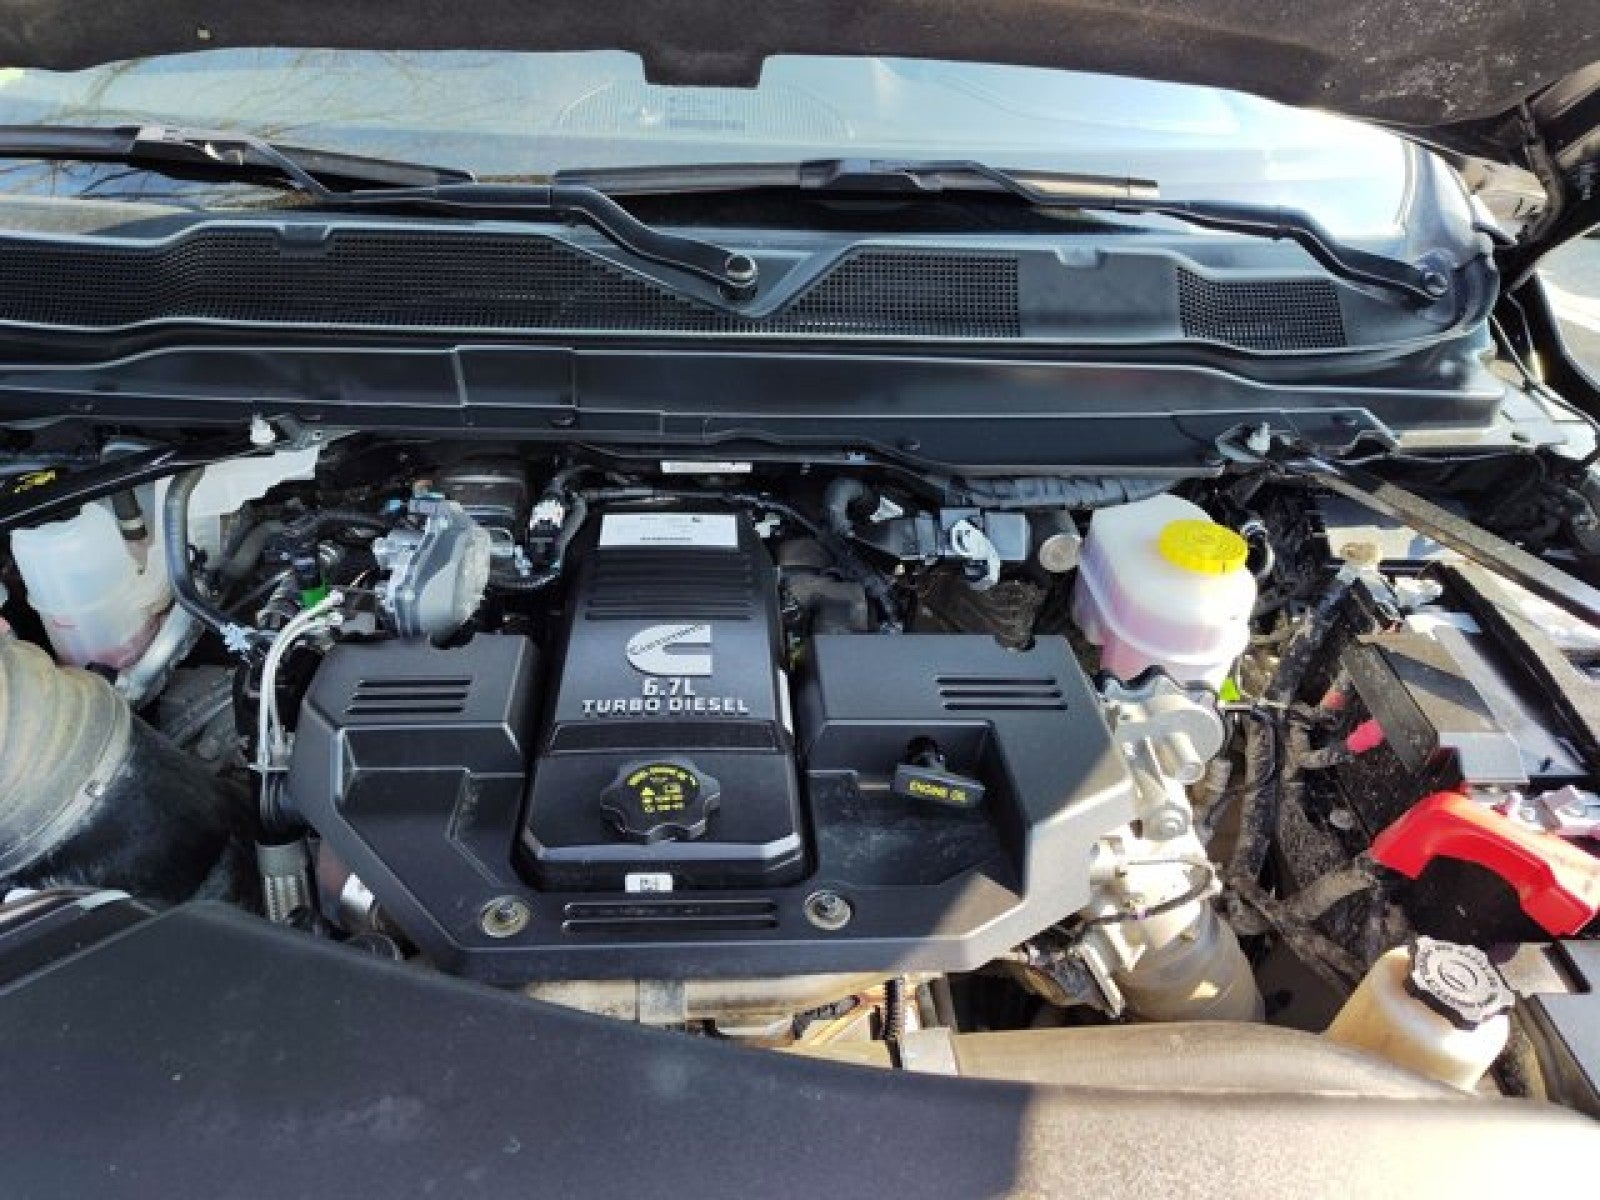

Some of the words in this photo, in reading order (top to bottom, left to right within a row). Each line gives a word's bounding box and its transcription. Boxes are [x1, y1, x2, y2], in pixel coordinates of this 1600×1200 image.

[643, 677, 696, 696] 6.7L
[582, 698, 660, 713] TURBO
[669, 698, 748, 713] DIESEL
[909, 781, 947, 797] ENGINE
